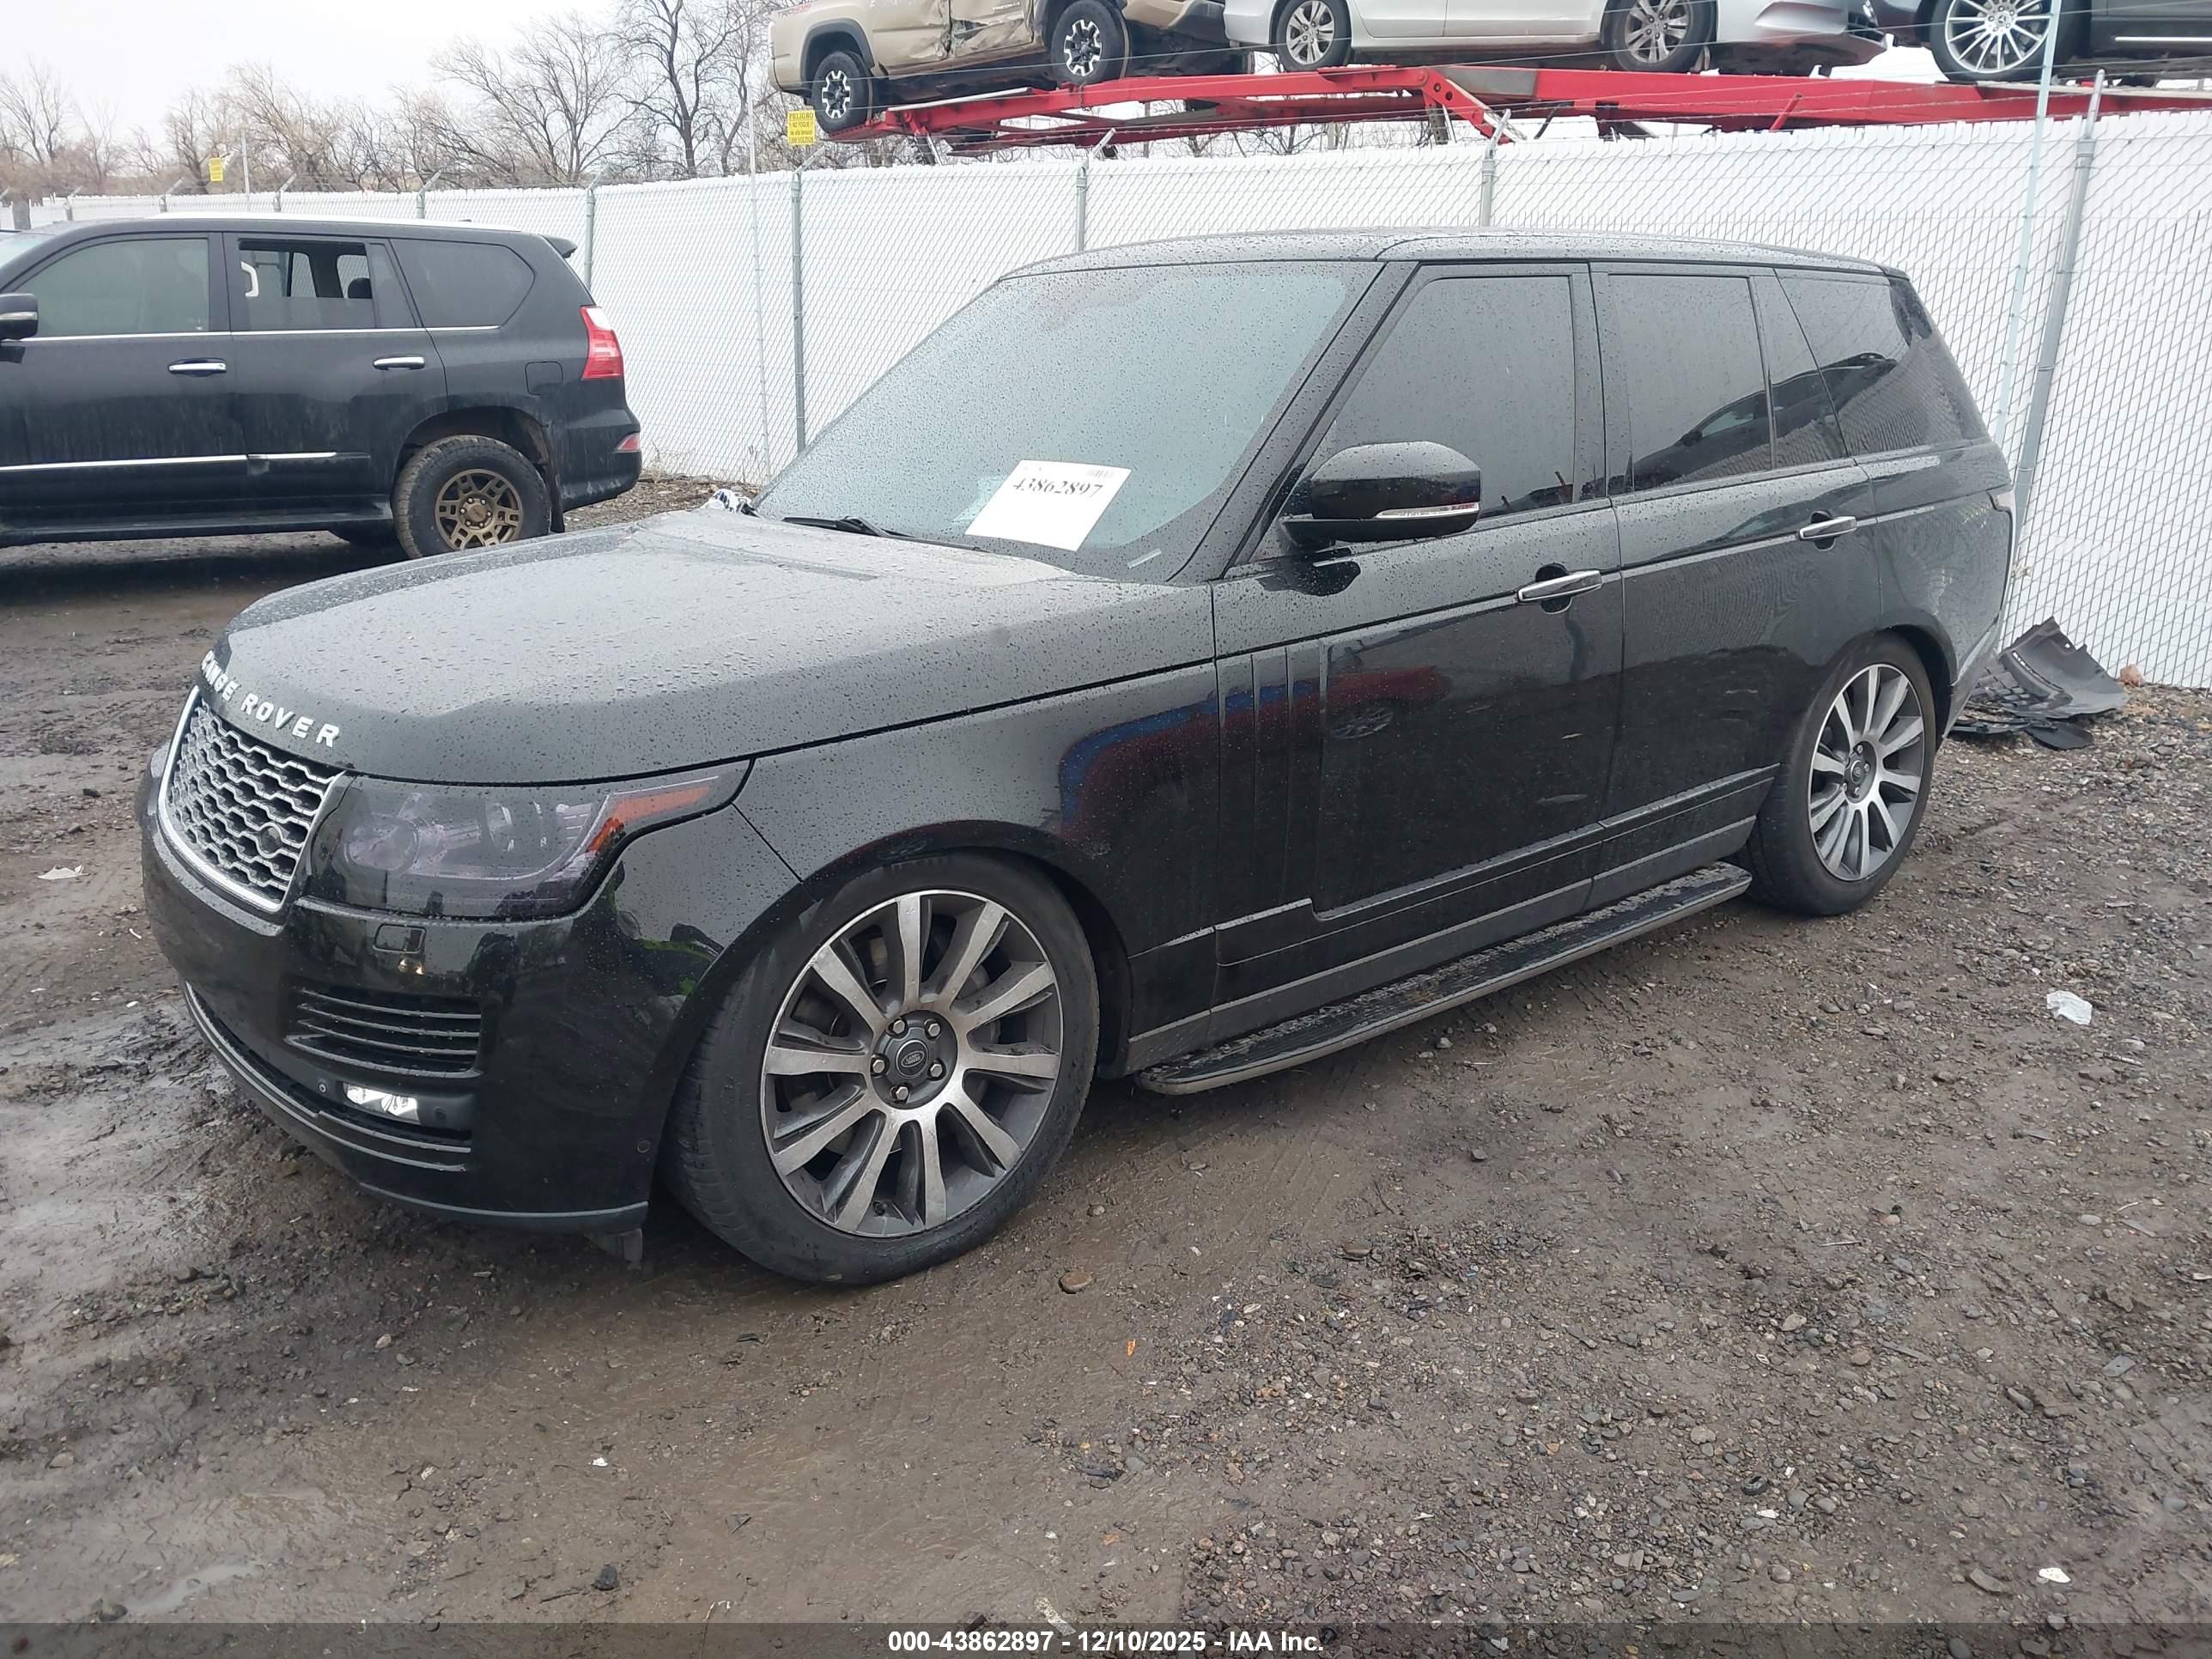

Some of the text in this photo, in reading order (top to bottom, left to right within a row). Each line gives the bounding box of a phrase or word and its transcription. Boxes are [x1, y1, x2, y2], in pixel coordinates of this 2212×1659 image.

[1013, 477, 1103, 497] 43862897
[202, 650, 340, 748] RANGE ROVER
